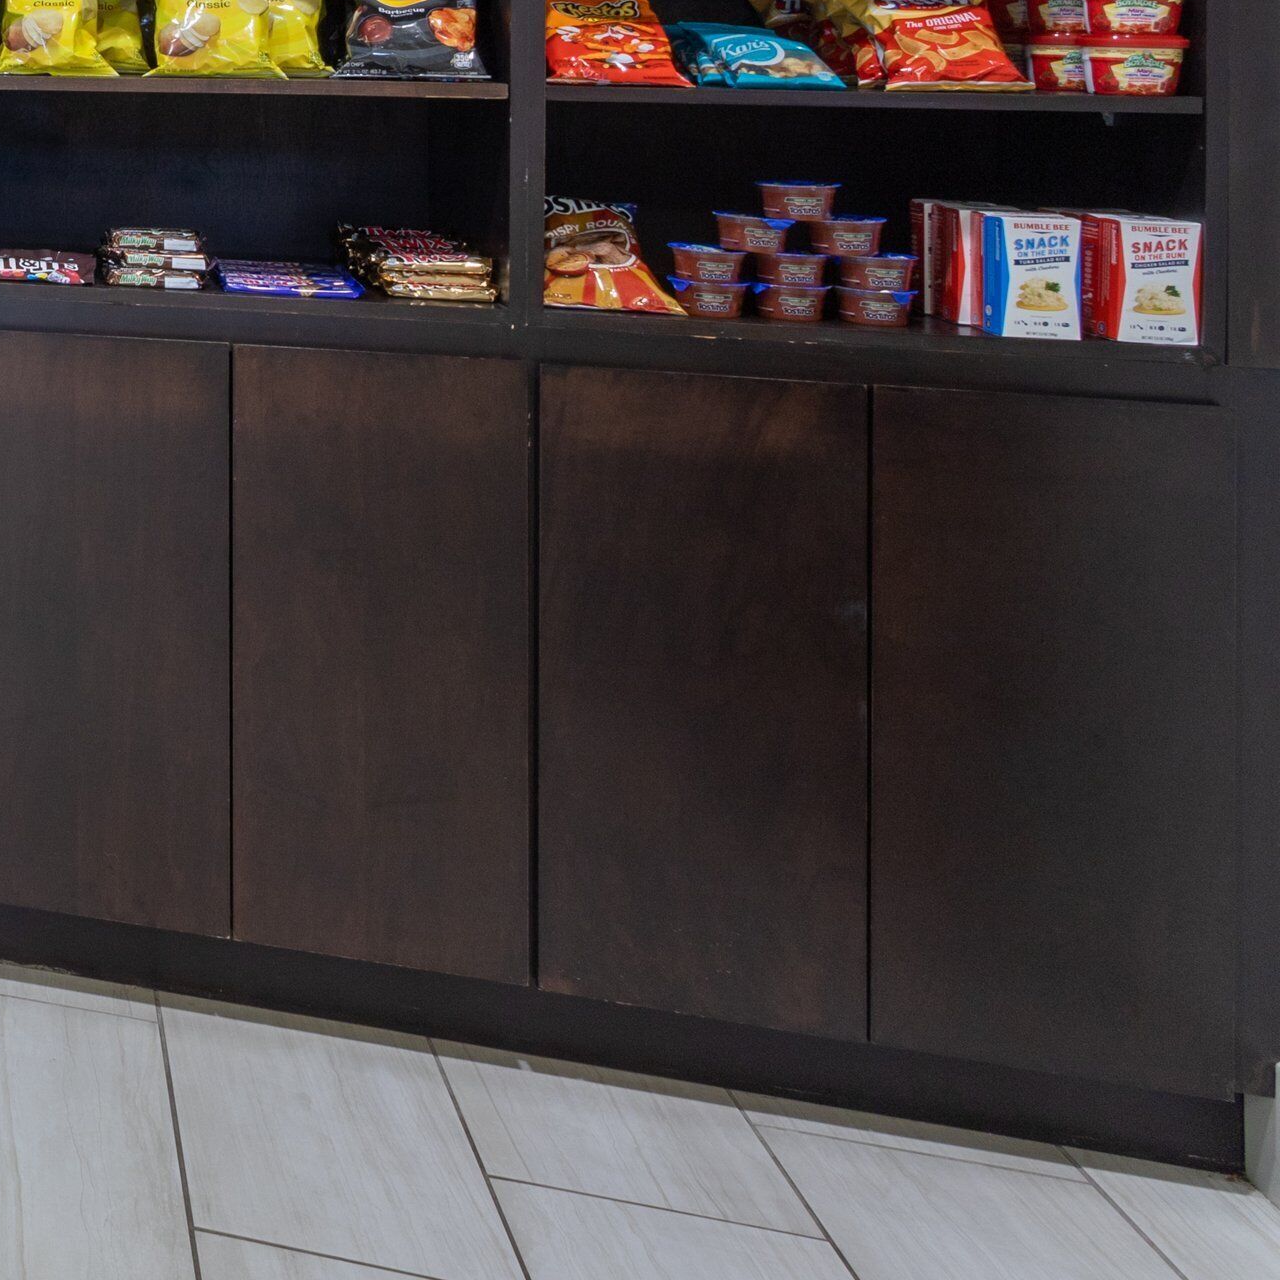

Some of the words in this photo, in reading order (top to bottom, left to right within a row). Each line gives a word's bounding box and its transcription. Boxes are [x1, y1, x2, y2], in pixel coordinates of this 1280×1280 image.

[33, 0, 75, 9] Classic
[378, 6, 425, 16] Barbecue
[905, 21, 923, 29] The
[925, 11, 982, 27] ORIGINAL
[1013, 223, 1050, 231] BUMBLE
[1052, 223, 1070, 231] BEE
[1013, 235, 1070, 251] SNACK
[1031, 249, 1046, 257] THE
[1048, 248, 1067, 256] RUN!
